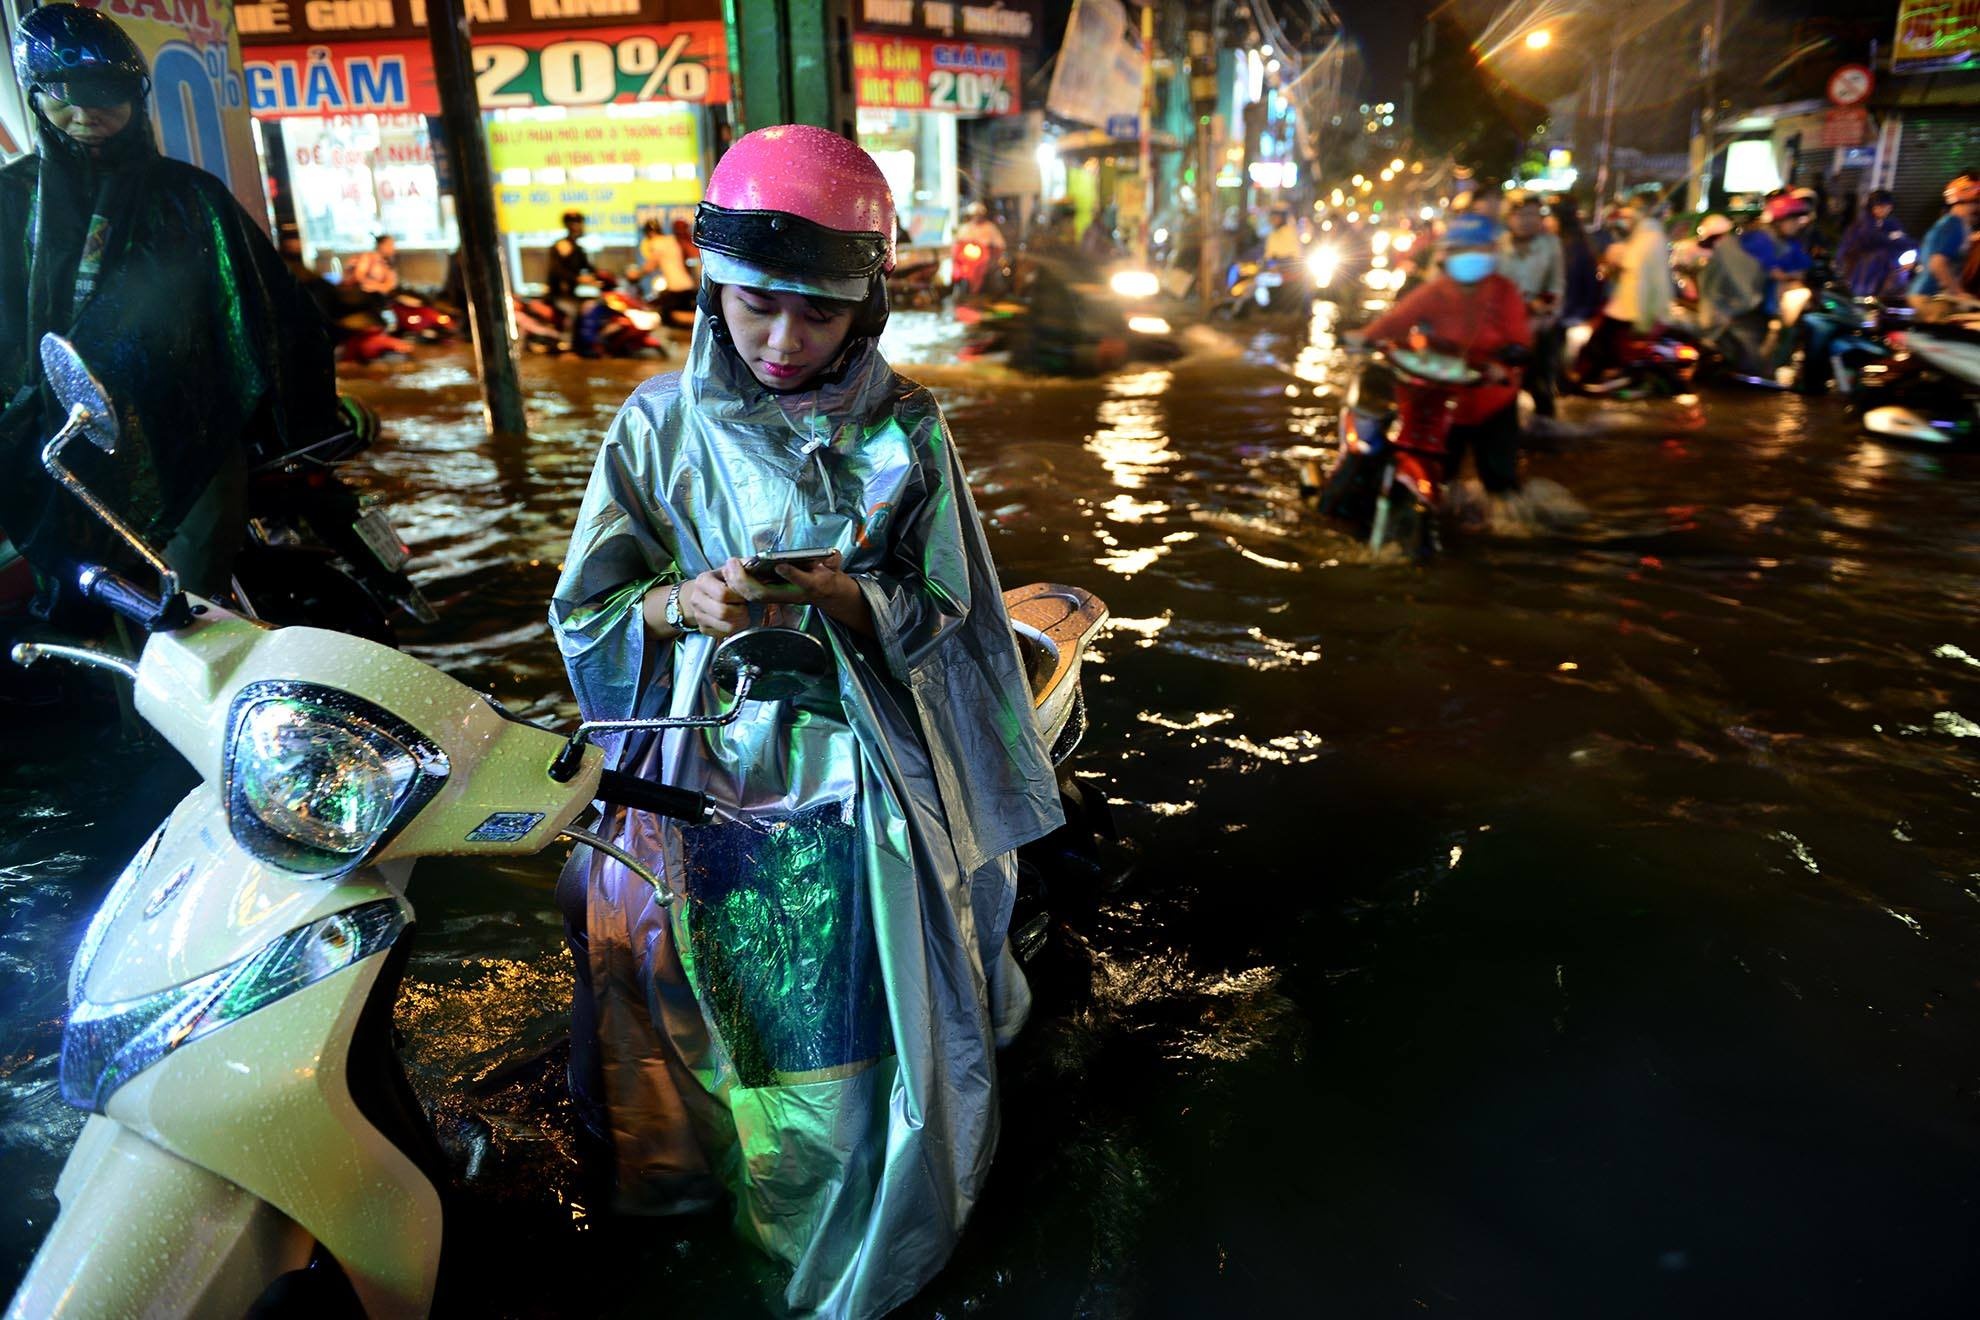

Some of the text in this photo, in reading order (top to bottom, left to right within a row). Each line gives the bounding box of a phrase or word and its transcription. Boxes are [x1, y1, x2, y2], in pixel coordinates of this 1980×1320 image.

[243, 33, 709, 114] GIẢM 20%
[928, 69, 1011, 114] 20%
